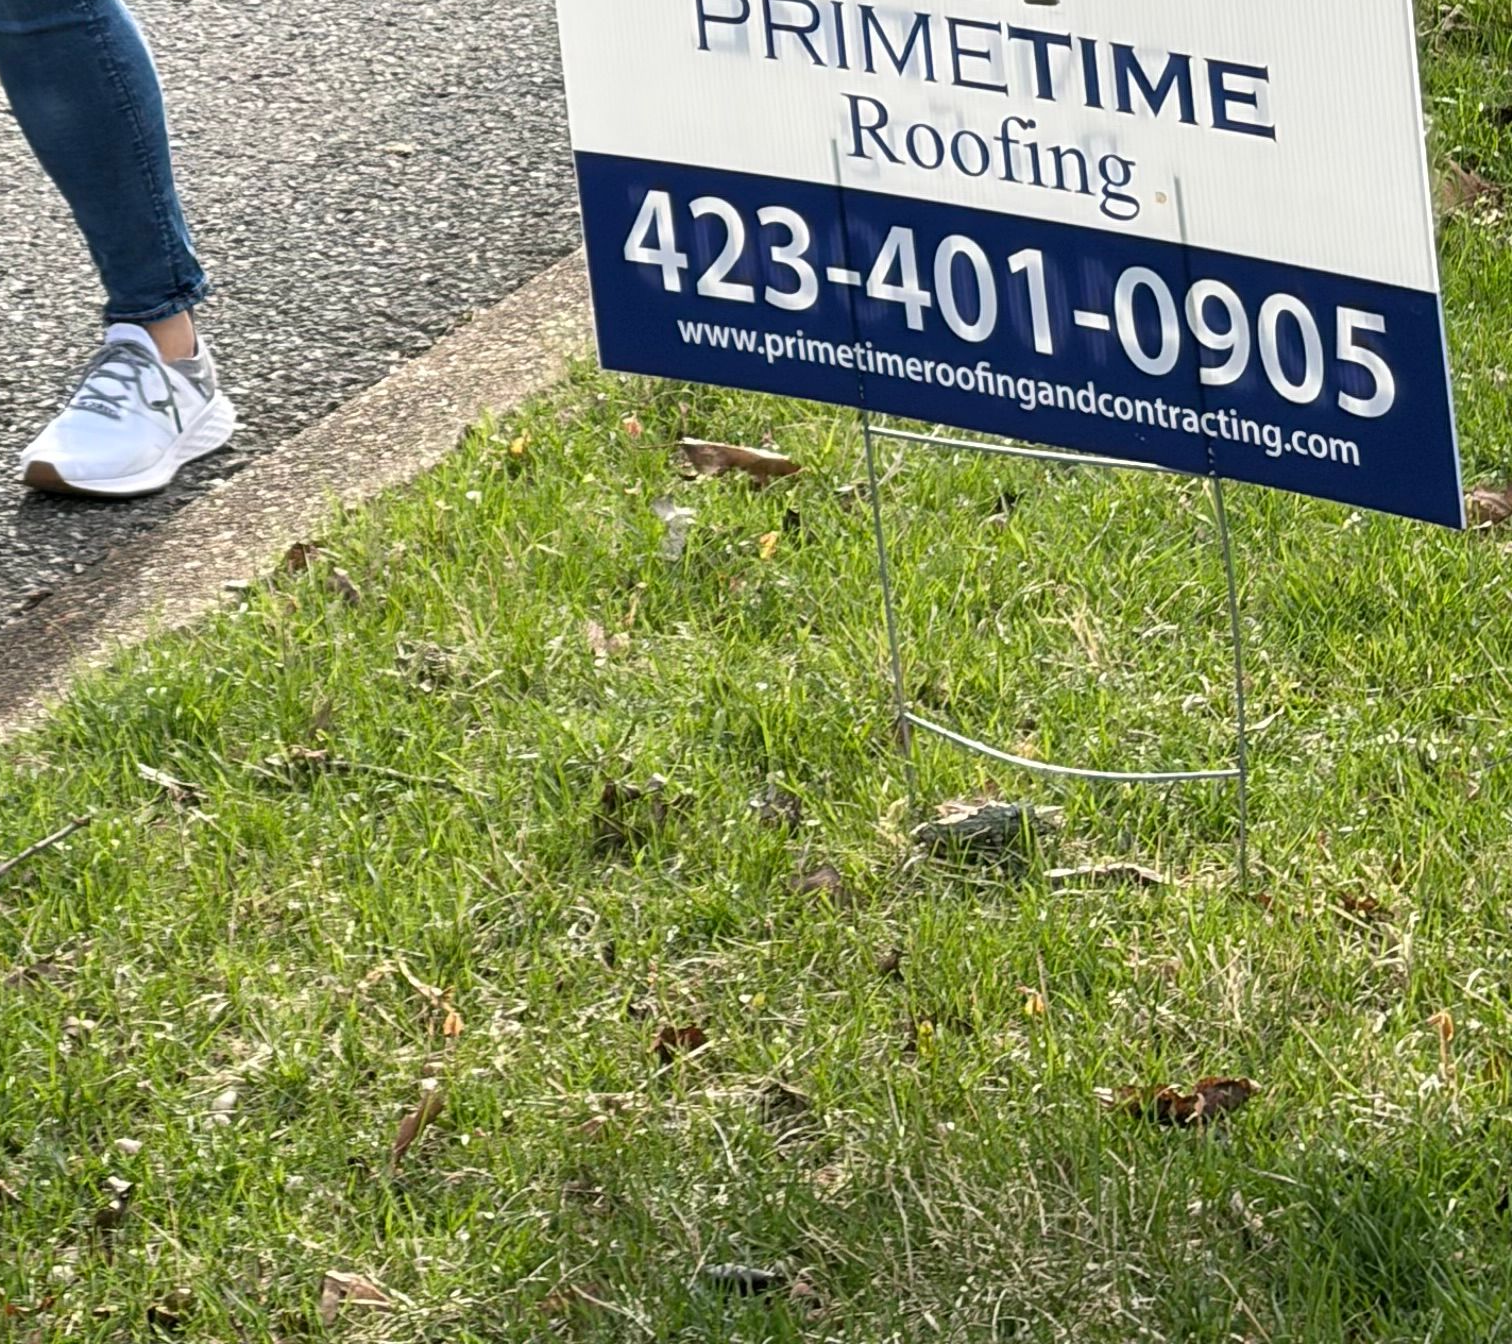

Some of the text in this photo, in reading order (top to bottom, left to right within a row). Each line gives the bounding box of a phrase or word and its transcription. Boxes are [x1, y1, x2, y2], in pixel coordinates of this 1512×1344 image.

[839, 92, 1141, 222] Roofing
[623, 189, 1396, 418] 423-401-0905
[676, 319, 1361, 467] www.primetimeroofingandcontracting.com
